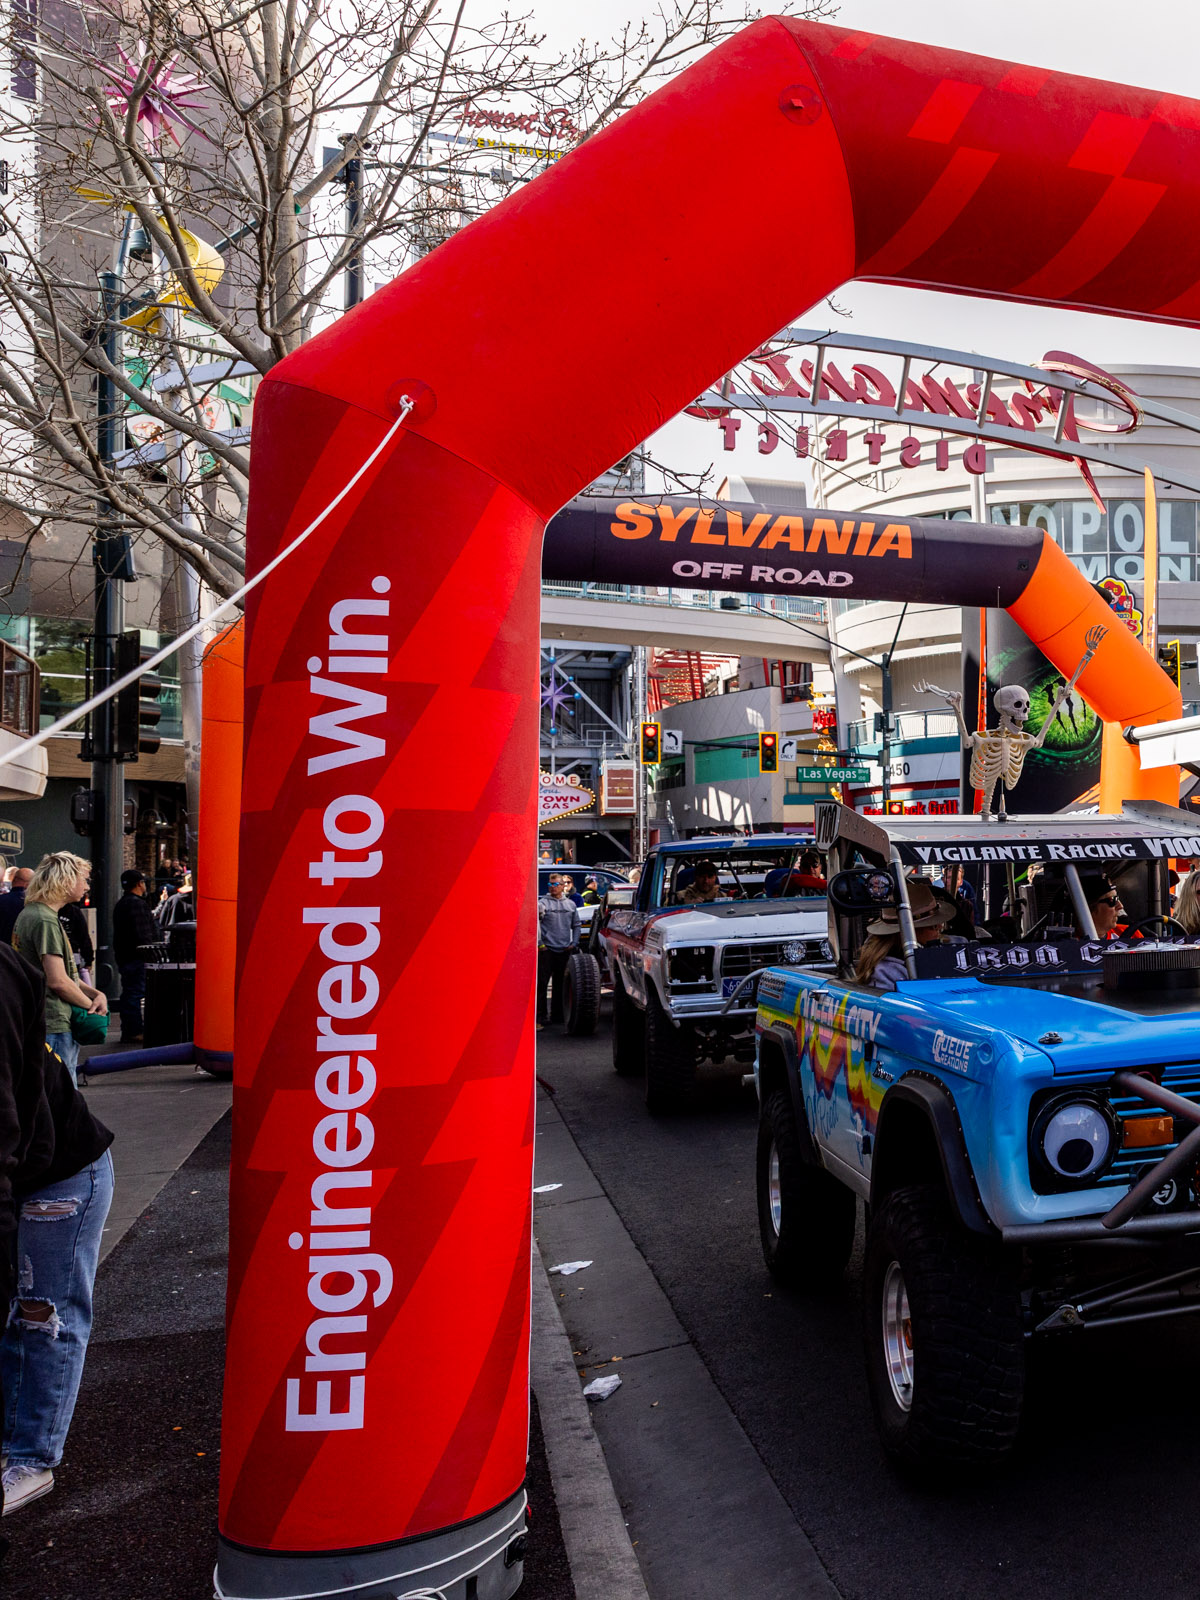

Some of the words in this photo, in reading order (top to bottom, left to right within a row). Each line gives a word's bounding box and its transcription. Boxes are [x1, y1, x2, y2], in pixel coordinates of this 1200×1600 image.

[477, 137, 564, 159] EXPERIENC
[610, 502, 913, 559] SYLVANIA
[672, 559, 744, 579] OFF
[752, 563, 854, 587] ROAD
[307, 574, 392, 777] Win.
[803, 768, 822, 778] Las
[824, 768, 857, 782] Vegas
[928, 799, 958, 815] Grill
[309, 794, 386, 886] to
[913, 844, 1042, 864] VIGILANTE
[1046, 843, 1136, 860] RACING
[954, 943, 1066, 974] IRON
[932, 1029, 973, 1060] QUEUE
[934, 1050, 968, 1073] CREATIONS
[285, 905, 394, 1433] Engineered
